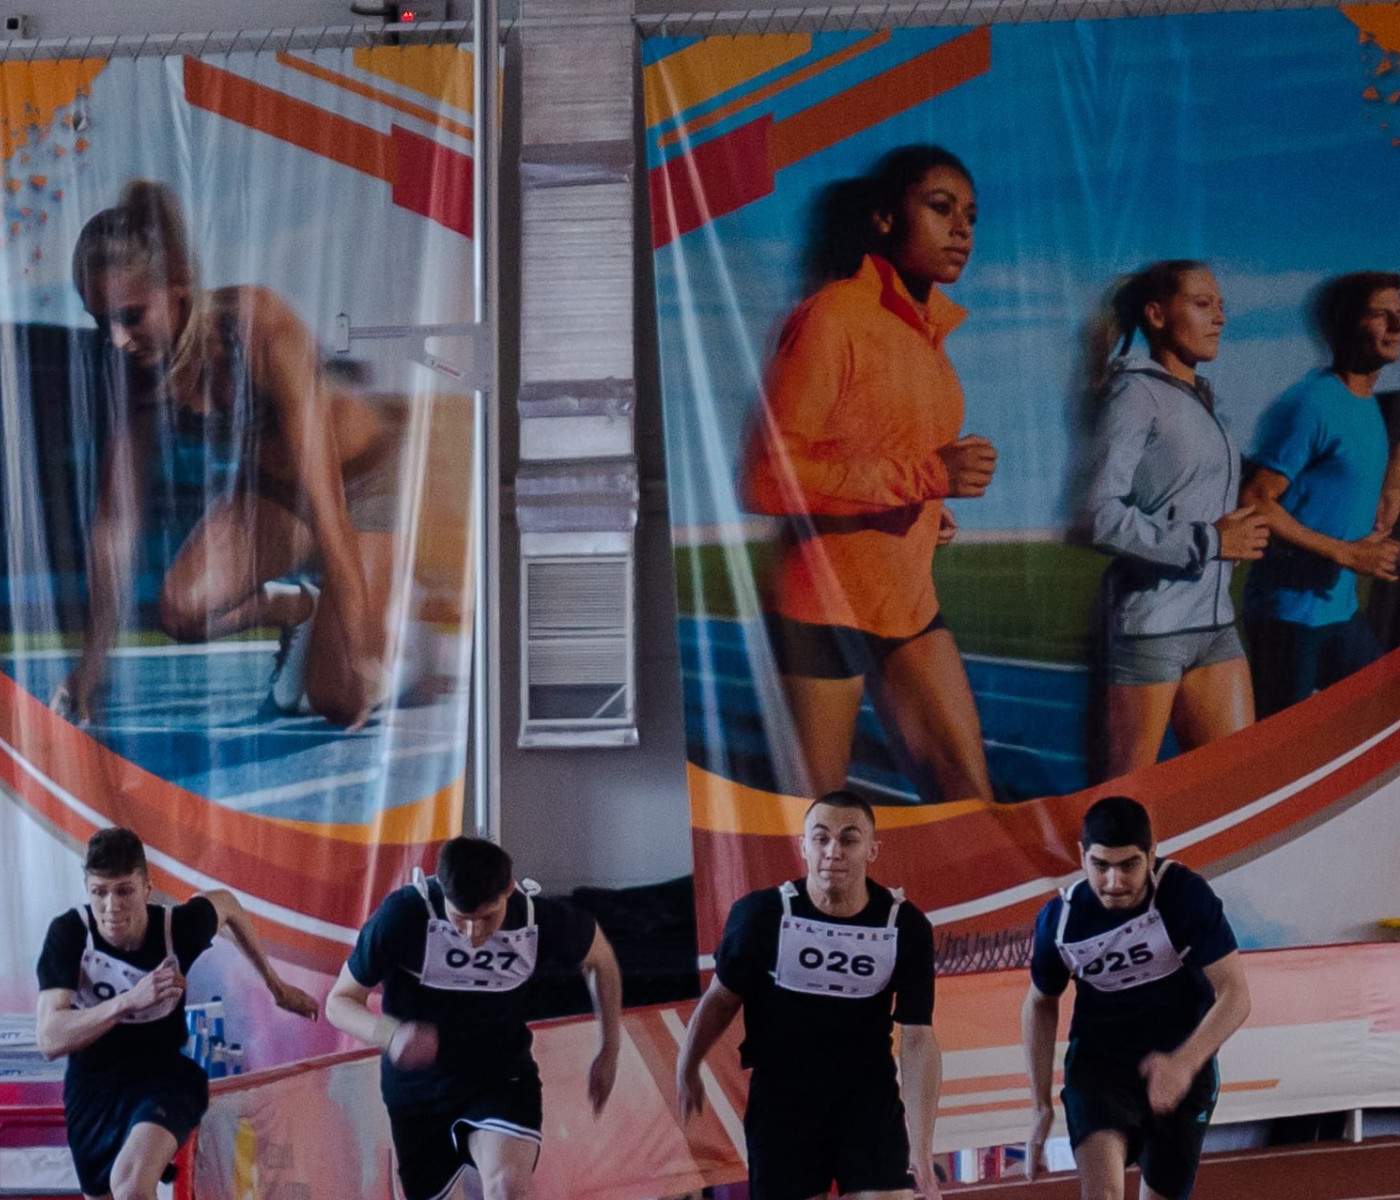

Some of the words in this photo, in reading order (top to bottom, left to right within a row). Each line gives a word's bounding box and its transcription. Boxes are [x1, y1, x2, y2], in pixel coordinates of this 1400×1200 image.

[446, 948, 519, 971] 027
[798, 947, 876, 977] 026
[1082, 942, 1154, 975] 025
